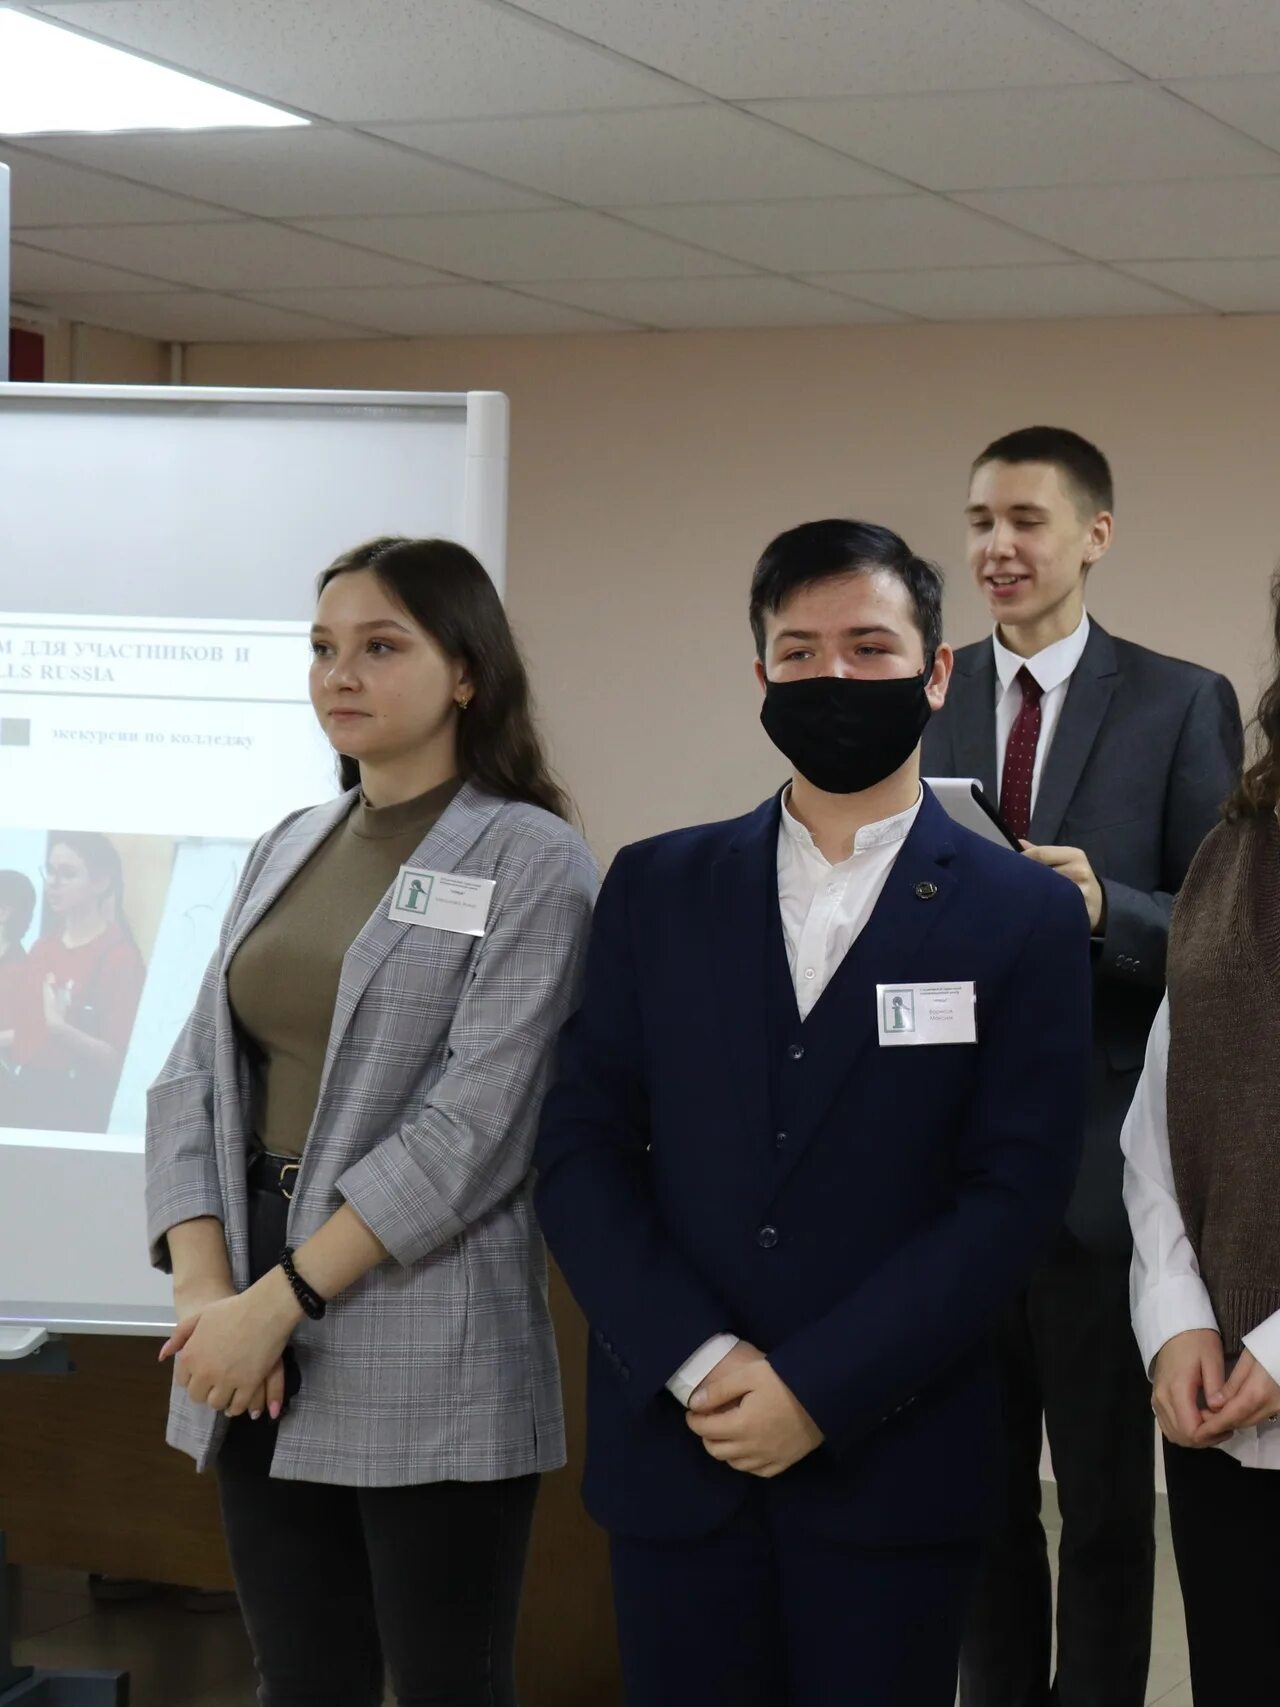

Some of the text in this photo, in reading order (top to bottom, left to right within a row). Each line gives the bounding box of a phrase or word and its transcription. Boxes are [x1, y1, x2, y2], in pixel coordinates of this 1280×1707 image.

[21, 640, 66, 657] ДЛЯ
[74, 641, 224, 662] УЧАСТНИКОВ
[40, 664, 115, 682] RUSSIA
[51, 727, 254, 750] экскурсии по колледжу
